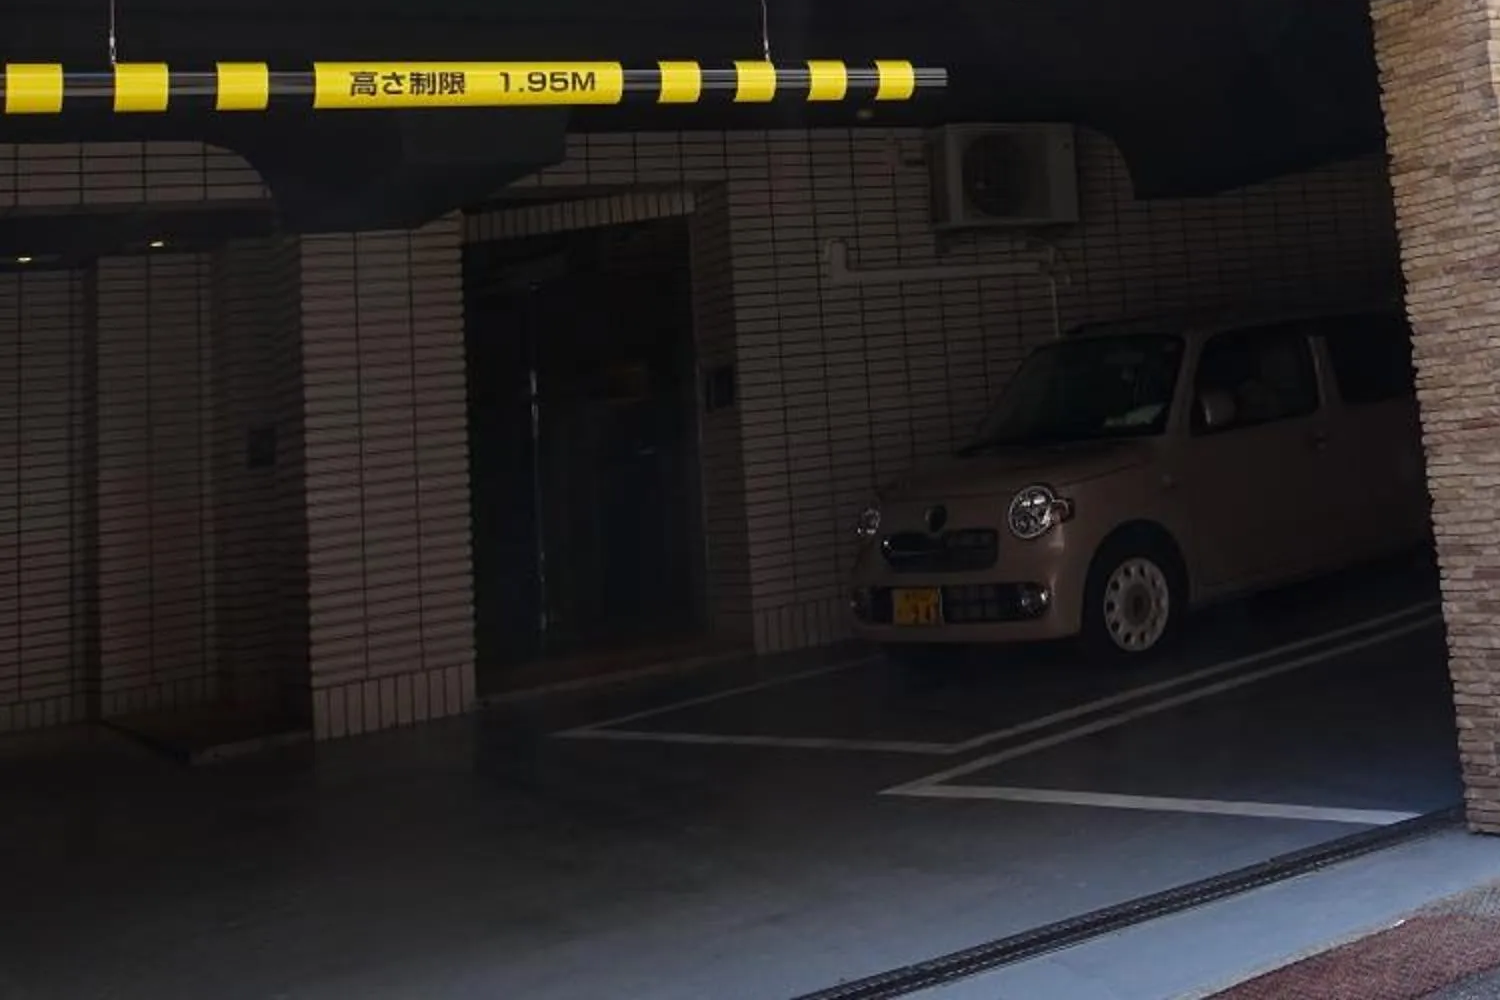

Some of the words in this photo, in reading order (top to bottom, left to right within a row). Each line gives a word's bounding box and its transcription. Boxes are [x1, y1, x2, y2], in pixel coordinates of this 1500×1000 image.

[349, 71, 466, 97] 高さ制限
[499, 71, 596, 93] 1.95M
